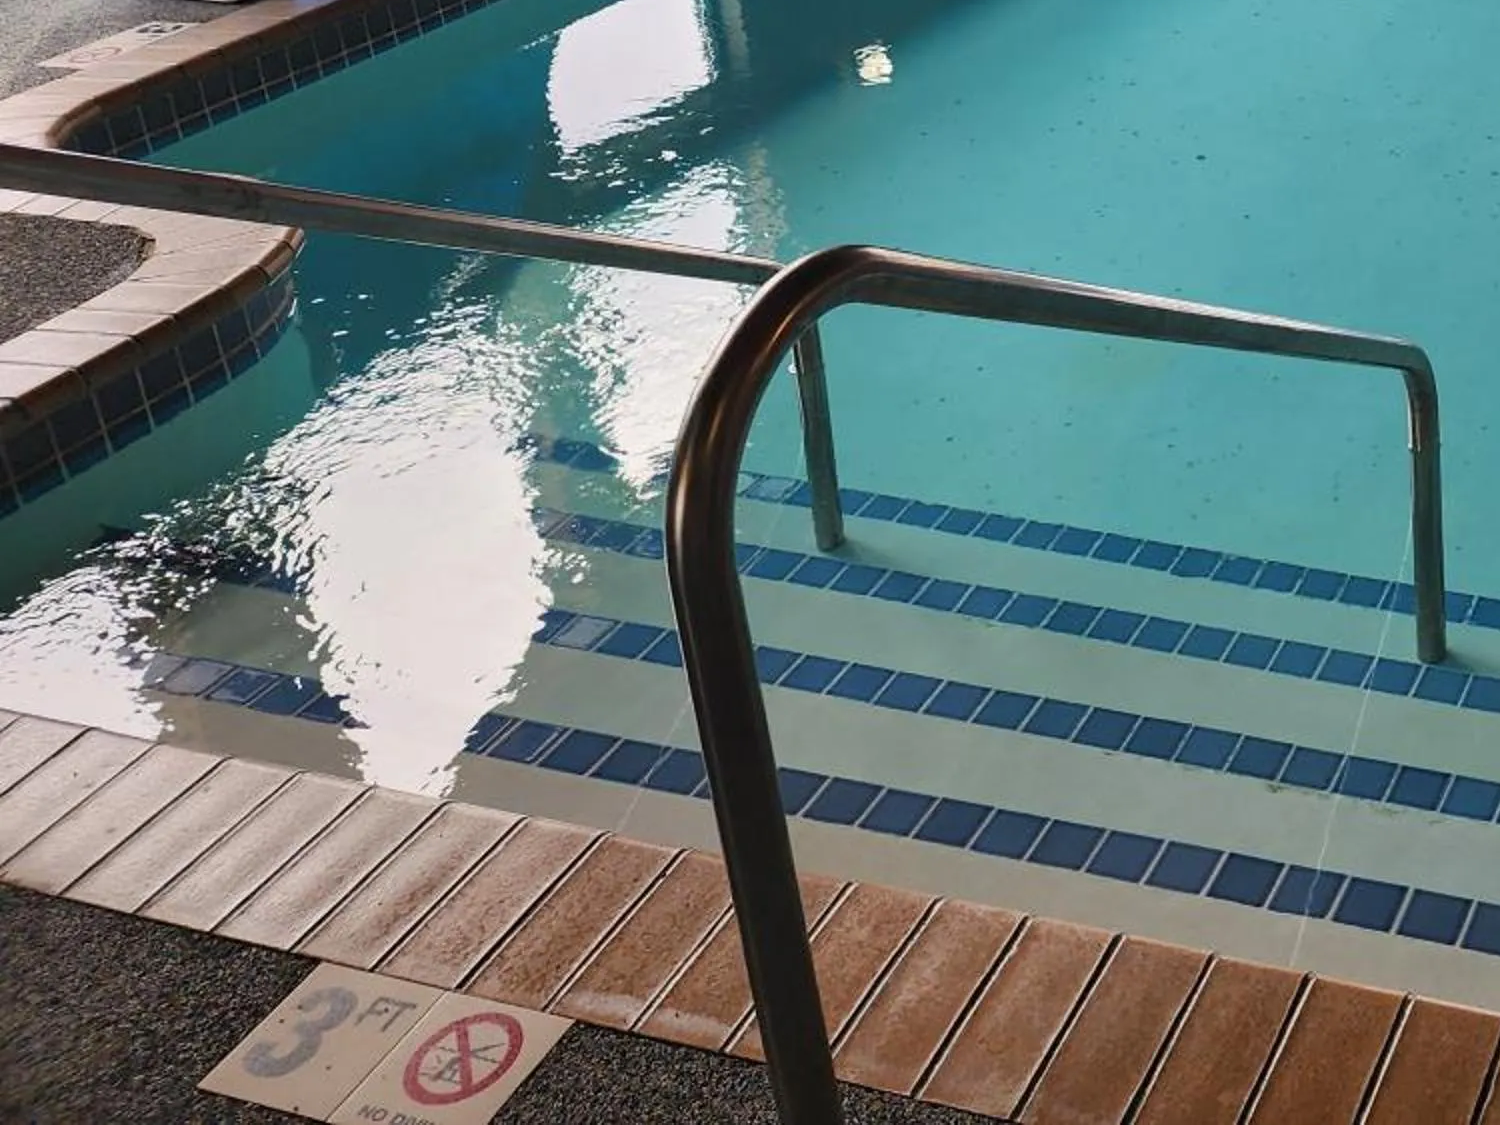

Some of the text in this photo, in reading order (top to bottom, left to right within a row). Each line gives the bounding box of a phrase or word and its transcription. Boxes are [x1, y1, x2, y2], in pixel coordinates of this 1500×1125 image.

[242, 986, 418, 1078] 3 FT
[357, 1104, 388, 1122] NO
